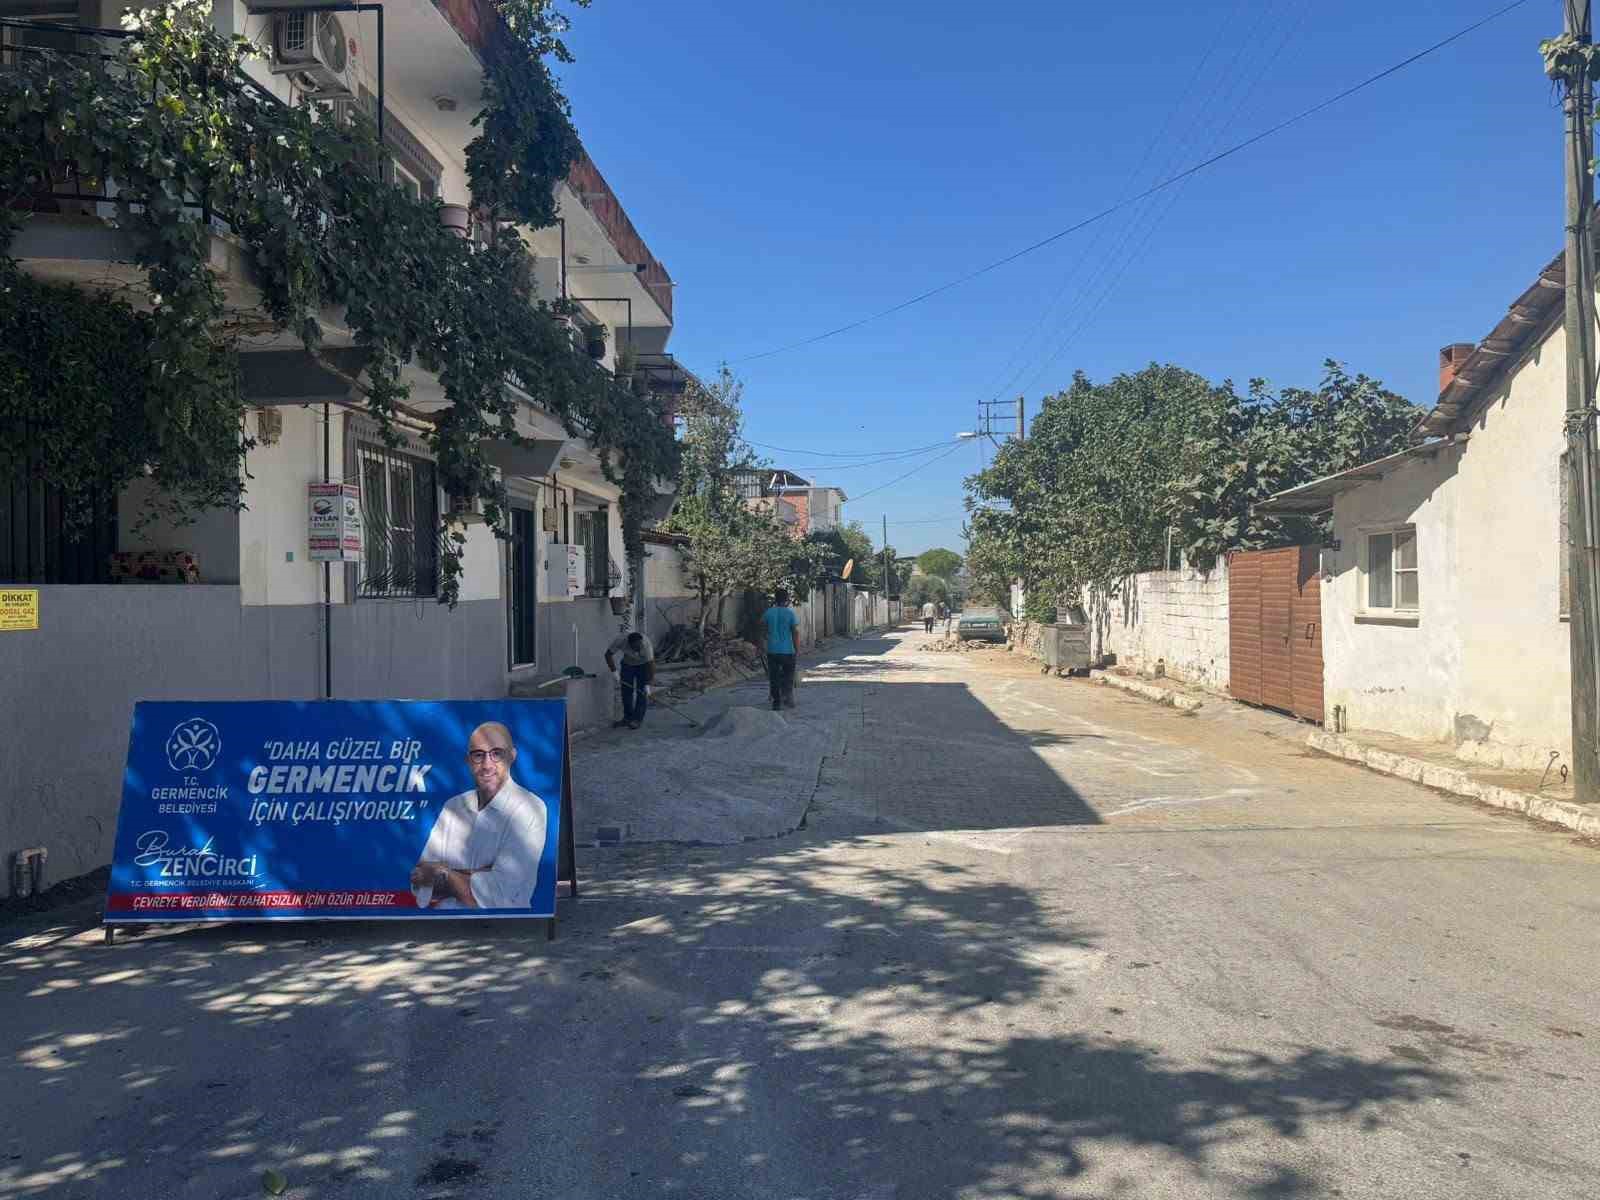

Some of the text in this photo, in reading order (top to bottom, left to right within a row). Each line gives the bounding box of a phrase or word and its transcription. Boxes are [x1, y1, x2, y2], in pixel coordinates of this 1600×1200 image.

[2, 592, 32, 601] DİKKAT
[326, 738, 383, 760] GÜZEL
[389, 737, 422, 760] BİR
[183, 776, 200, 787] T.C.
[247, 757, 432, 794] GERMENCİK
[151, 785, 228, 800] GERMENCİK
[158, 802, 217, 814] BELEDİYESİ
[249, 798, 288, 826] İÇİN
[134, 830, 218, 866] Burak
[159, 854, 257, 877] ZENCİRCİ
[132, 895, 180, 911] ÇEVREYE
[180, 891, 236, 909] VERDİĞİMİZ
[238, 894, 301, 907] RAHATSIZLIK
[304, 892, 326, 908] İÇİN
[328, 892, 354, 905] ÖZÜR
